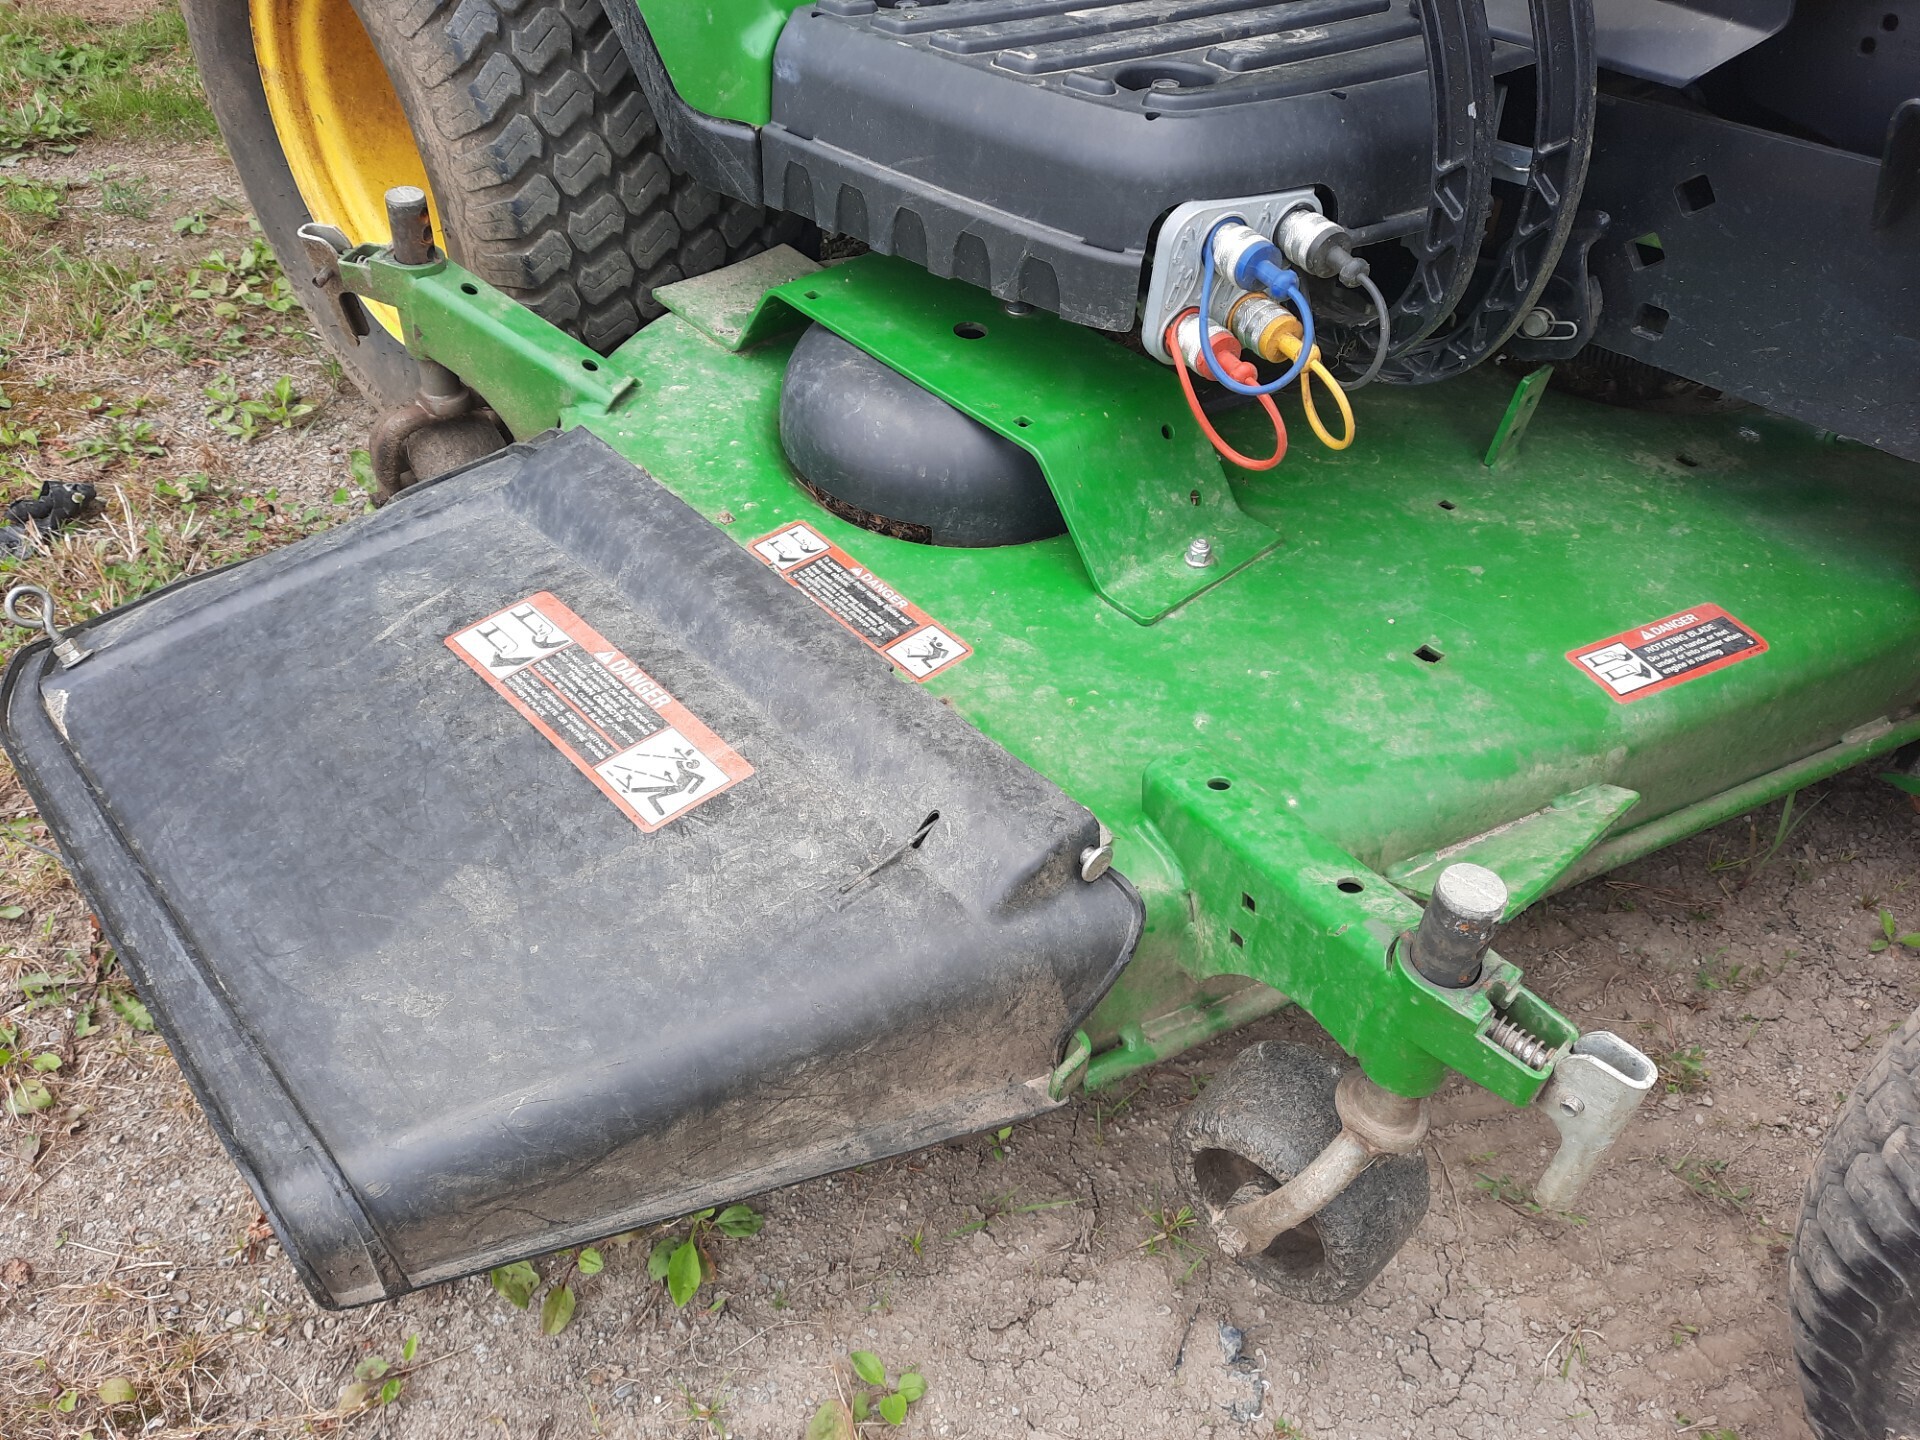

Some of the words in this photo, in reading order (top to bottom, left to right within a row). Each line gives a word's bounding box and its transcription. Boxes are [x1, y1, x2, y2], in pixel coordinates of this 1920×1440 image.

[814, 559, 834, 573] thrown
[807, 586, 822, 597] grass
[808, 565, 822, 574] Keep
[838, 587, 850, 596] feet
[845, 594, 860, 604] away
[856, 602, 870, 611] from
[865, 609, 886, 624] rotating
[818, 587, 836, 599] mower
[832, 598, 851, 611] without
[846, 609, 872, 628] discharge
[868, 625, 883, 636] chute
[826, 561, 844, 573] avoid
[838, 571, 857, 583] injury
[852, 580, 868, 591] from
[862, 589, 886, 606] rotating
[881, 603, 902, 617] blades
[898, 615, 912, 625] and
[837, 595, 850, 603] safe
[859, 572, 910, 609] DANGER
[1642, 633, 1690, 653] ROTATING
[1685, 623, 1717, 637] BLADE
[1645, 653, 1661, 662] Do
[1657, 650, 1673, 658] not
[1670, 645, 1687, 654] put
[1681, 636, 1708, 649] hands
[1712, 628, 1730, 637] feet
[1648, 613, 1699, 635] DANGER
[1652, 655, 1678, 667] under
[1682, 647, 1701, 656] into
[1698, 639, 1725, 651] mower
[1720, 631, 1744, 642] when
[1659, 660, 1691, 675] engine
[1684, 657, 1697, 665] is
[1692, 647, 1725, 663] running
[503, 677, 527, 698] CATCHER
[533, 662, 548, 674] THAT
[544, 673, 558, 683] MAY
[554, 681, 564, 689] BE
[560, 687, 585, 707] THROWN
[580, 706, 591, 714] BY
[540, 659, 560, 675] BEFORE
[576, 691, 595, 706] CLEAR
[591, 705, 607, 718] AREA
[610, 722, 636, 743] OBJECTS
[555, 652, 569, 663] INTO
[565, 661, 587, 679] MOWER
[584, 678, 603, 693] WHEN
[599, 691, 621, 709] ENGINE
[624, 713, 651, 735] RUNNING
[562, 648, 573, 657] DO
[569, 655, 583, 665] NOT
[580, 664, 593, 674] PUT
[589, 672, 611, 689] HANDS
[607, 688, 619, 696] OR
[615, 695, 631, 707] FEET
[627, 706, 650, 724] UNDER
[646, 722, 658, 731] OR
[564, 670, 596, 696] THROWN
[591, 694, 625, 722] OBJECTS
[588, 661, 623, 689] ROTATING
[619, 688, 644, 708] BLADE
[607, 658, 673, 709] DANGER
[511, 673, 541, 700] DISCHARGE
[538, 699, 559, 716] CHUTE
[555, 715, 568, 724] OR
[564, 723, 587, 742] ENTIRE
[583, 741, 606, 759] GRASS
[518, 670, 529, 678] DO
[527, 678, 542, 690] NOT
[540, 689, 565, 711] OPERATE
[563, 711, 587, 731] MOWER
[585, 731, 614, 755] WITHOUT
